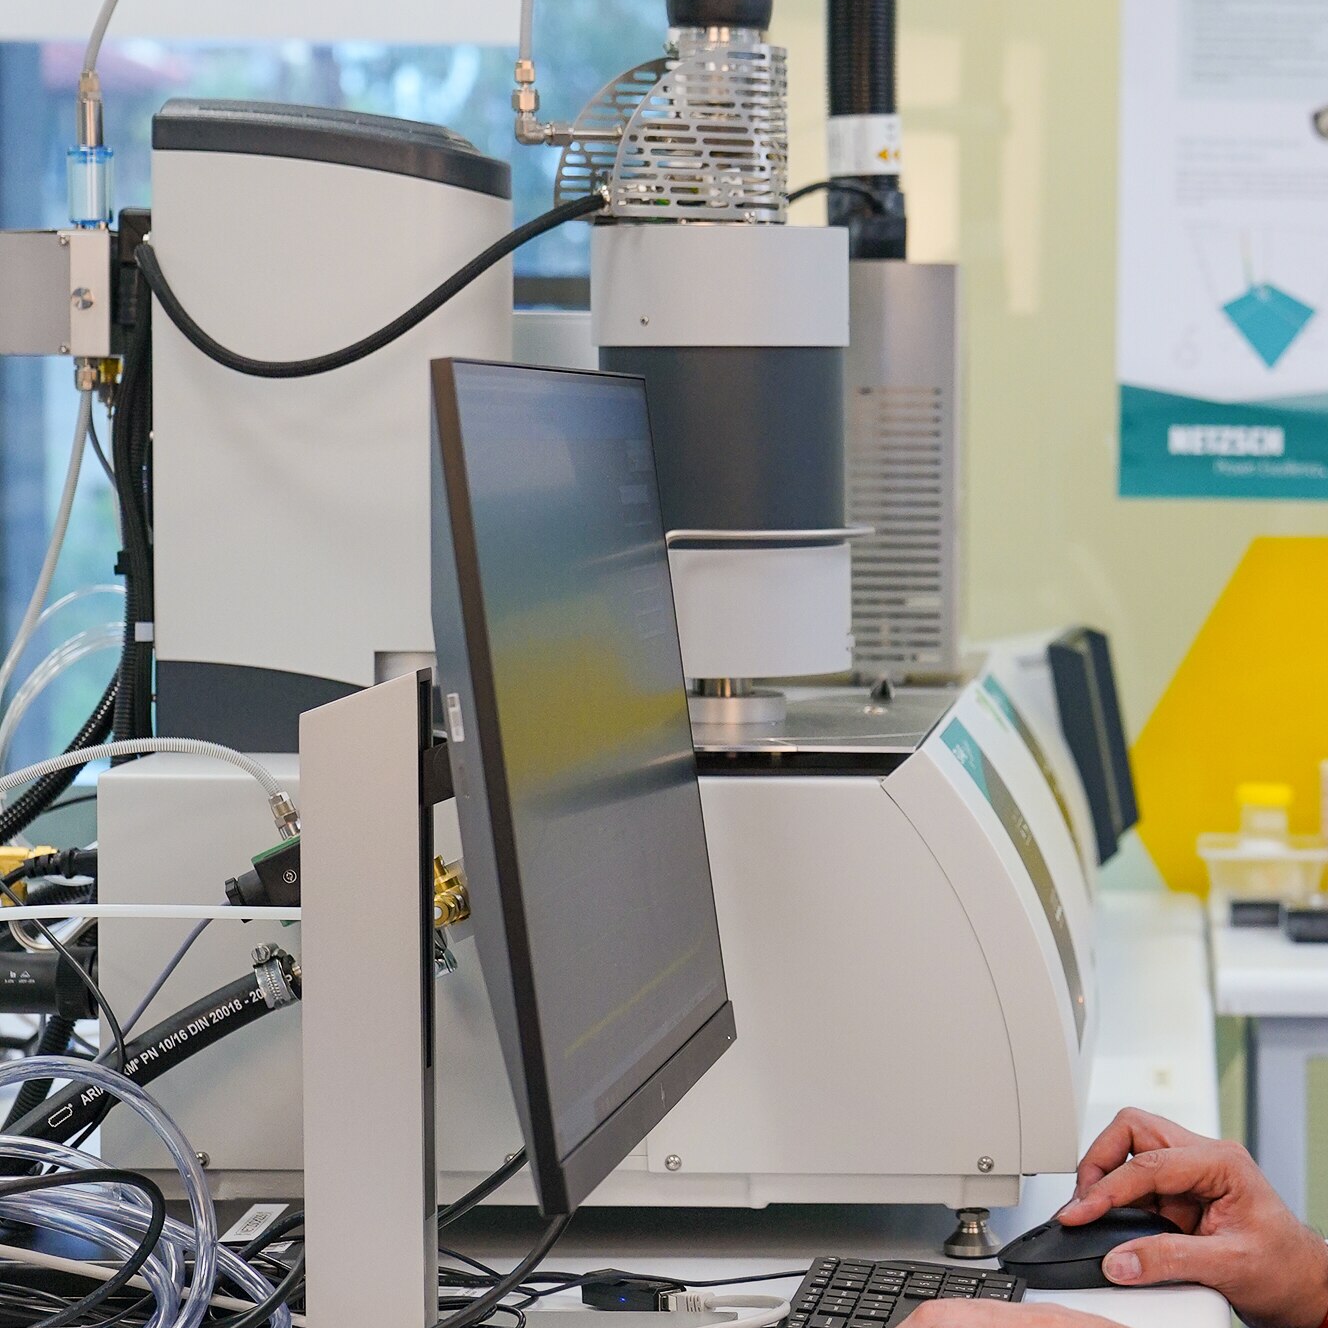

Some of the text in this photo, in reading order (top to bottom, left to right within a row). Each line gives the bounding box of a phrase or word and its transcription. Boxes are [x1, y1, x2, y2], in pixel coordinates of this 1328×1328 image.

[1167, 424, 1285, 456] NETZSCH
[140, 1047, 159, 1065] PN
[158, 1029, 188, 1053] 10/16
[187, 1016, 210, 1036] DIN
[209, 999, 243, 1024] 20018
